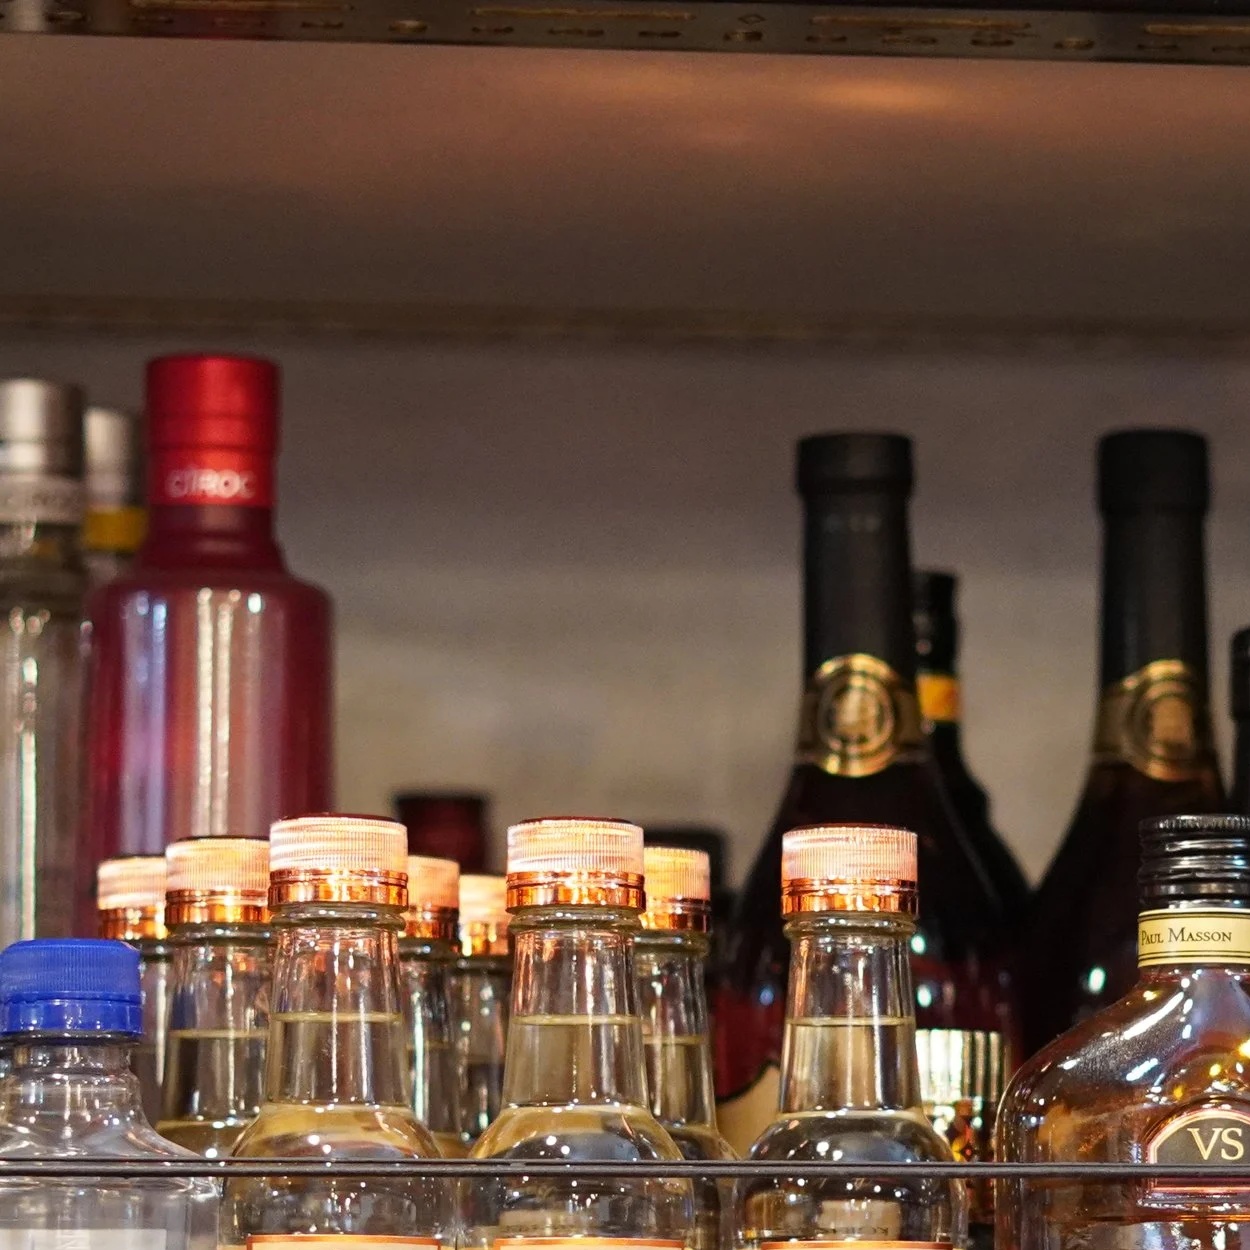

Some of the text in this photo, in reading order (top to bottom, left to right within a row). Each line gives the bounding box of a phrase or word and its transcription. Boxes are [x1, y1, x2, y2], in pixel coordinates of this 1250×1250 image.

[1141, 926, 1232, 946] PAUL MASSON
[1187, 1126, 1245, 1161] VS
